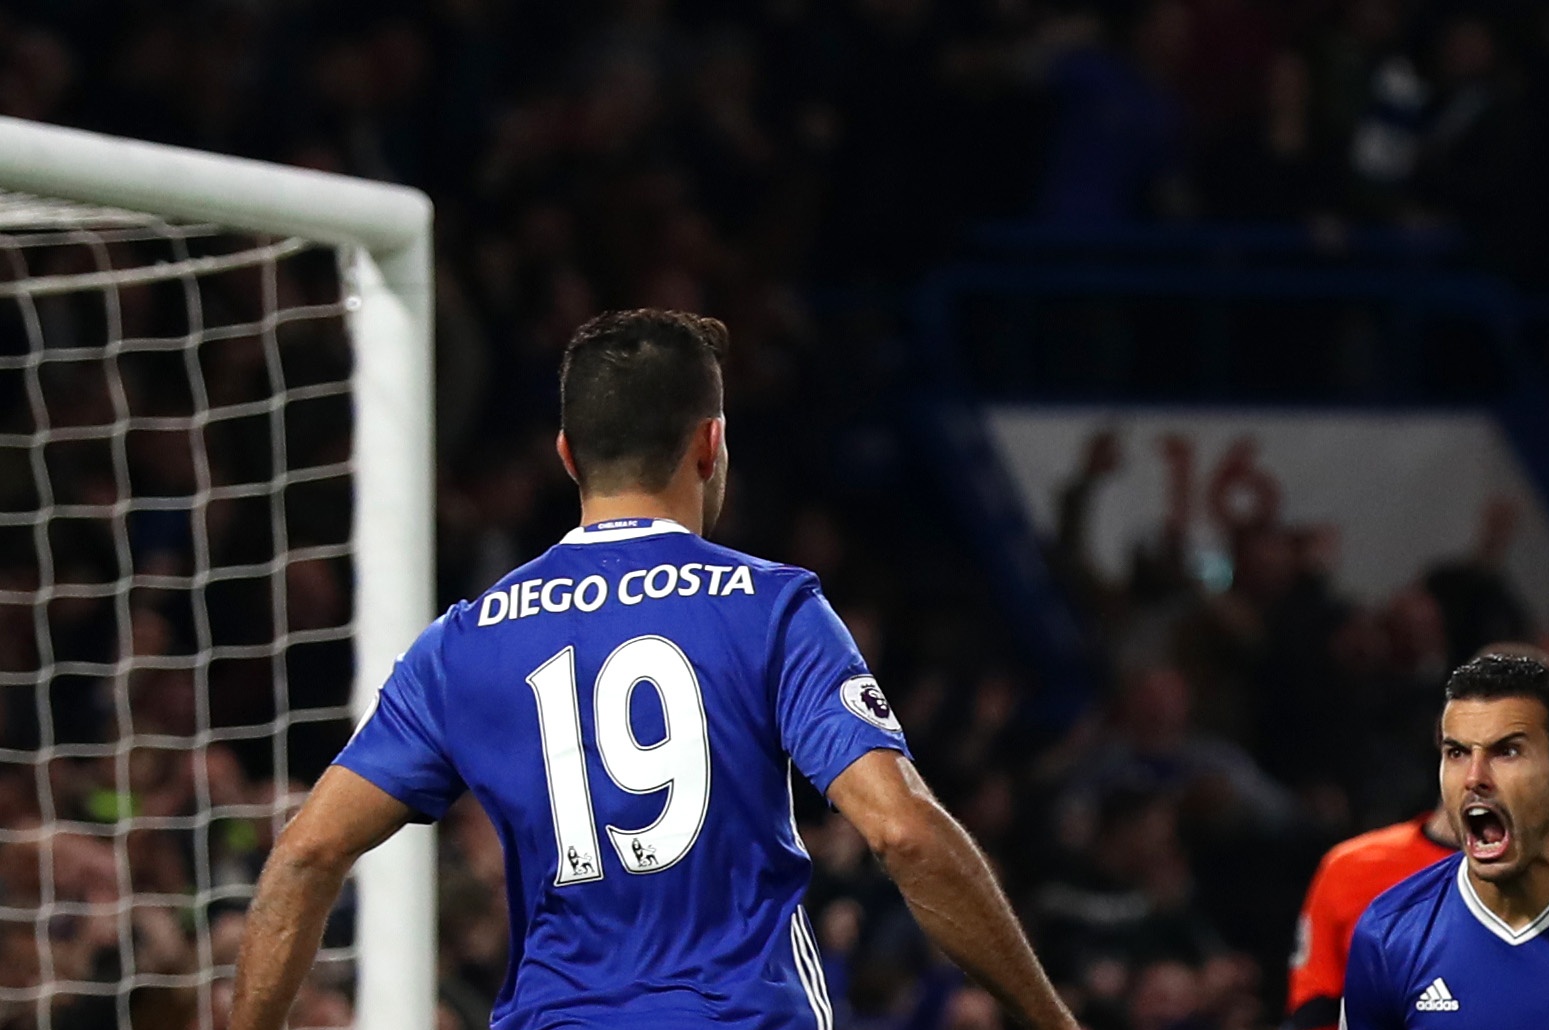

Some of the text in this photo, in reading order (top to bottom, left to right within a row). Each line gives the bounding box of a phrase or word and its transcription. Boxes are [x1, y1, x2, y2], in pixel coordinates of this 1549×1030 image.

[1158, 432, 1284, 540] 16
[477, 563, 755, 627] DIEGO COSTA
[525, 634, 712, 887] 19
[1415, 998, 1460, 1012] adidas
